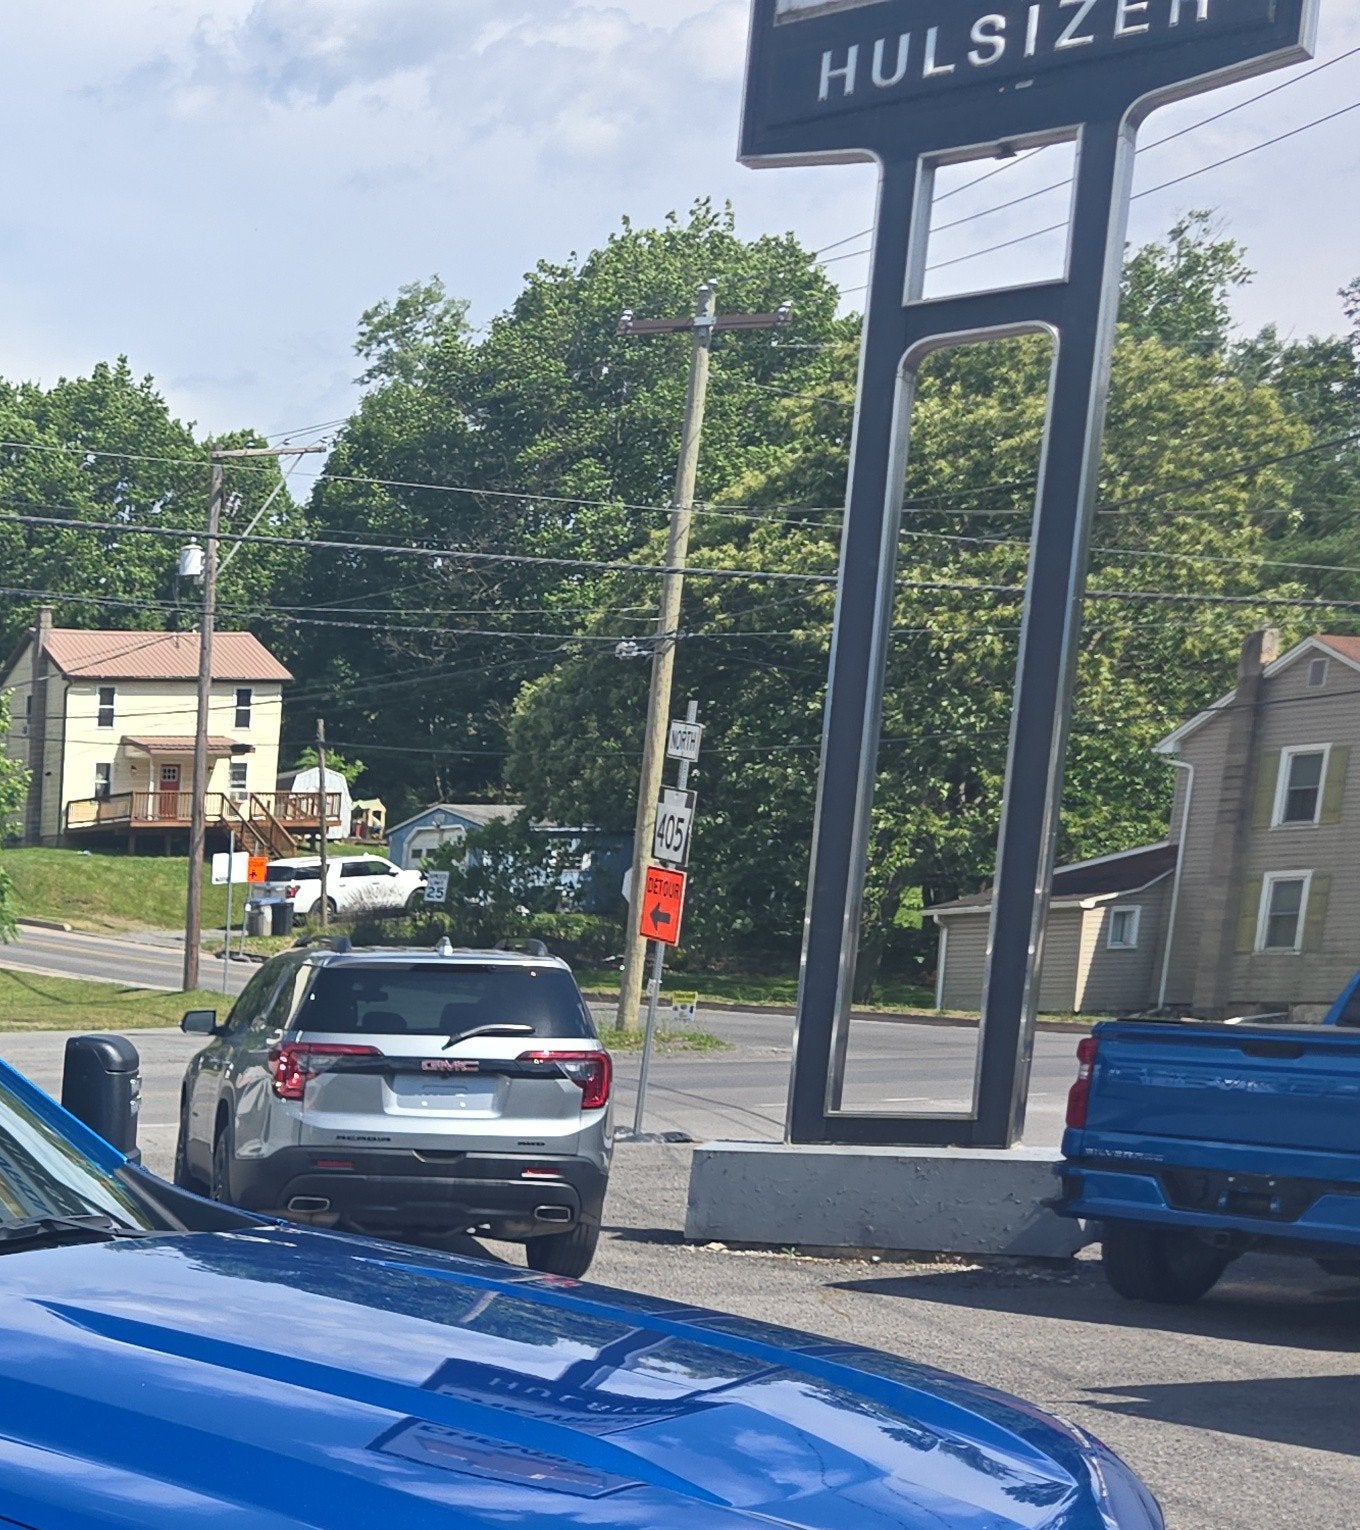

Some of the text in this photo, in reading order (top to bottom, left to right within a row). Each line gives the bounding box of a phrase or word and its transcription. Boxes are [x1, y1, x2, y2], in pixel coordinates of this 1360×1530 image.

[669, 729, 697, 752] NORTH
[656, 813, 685, 852] 405
[427, 886, 444, 898] 25
[647, 876, 681, 900] DETOUR
[421, 1060, 480, 1072] GMC
